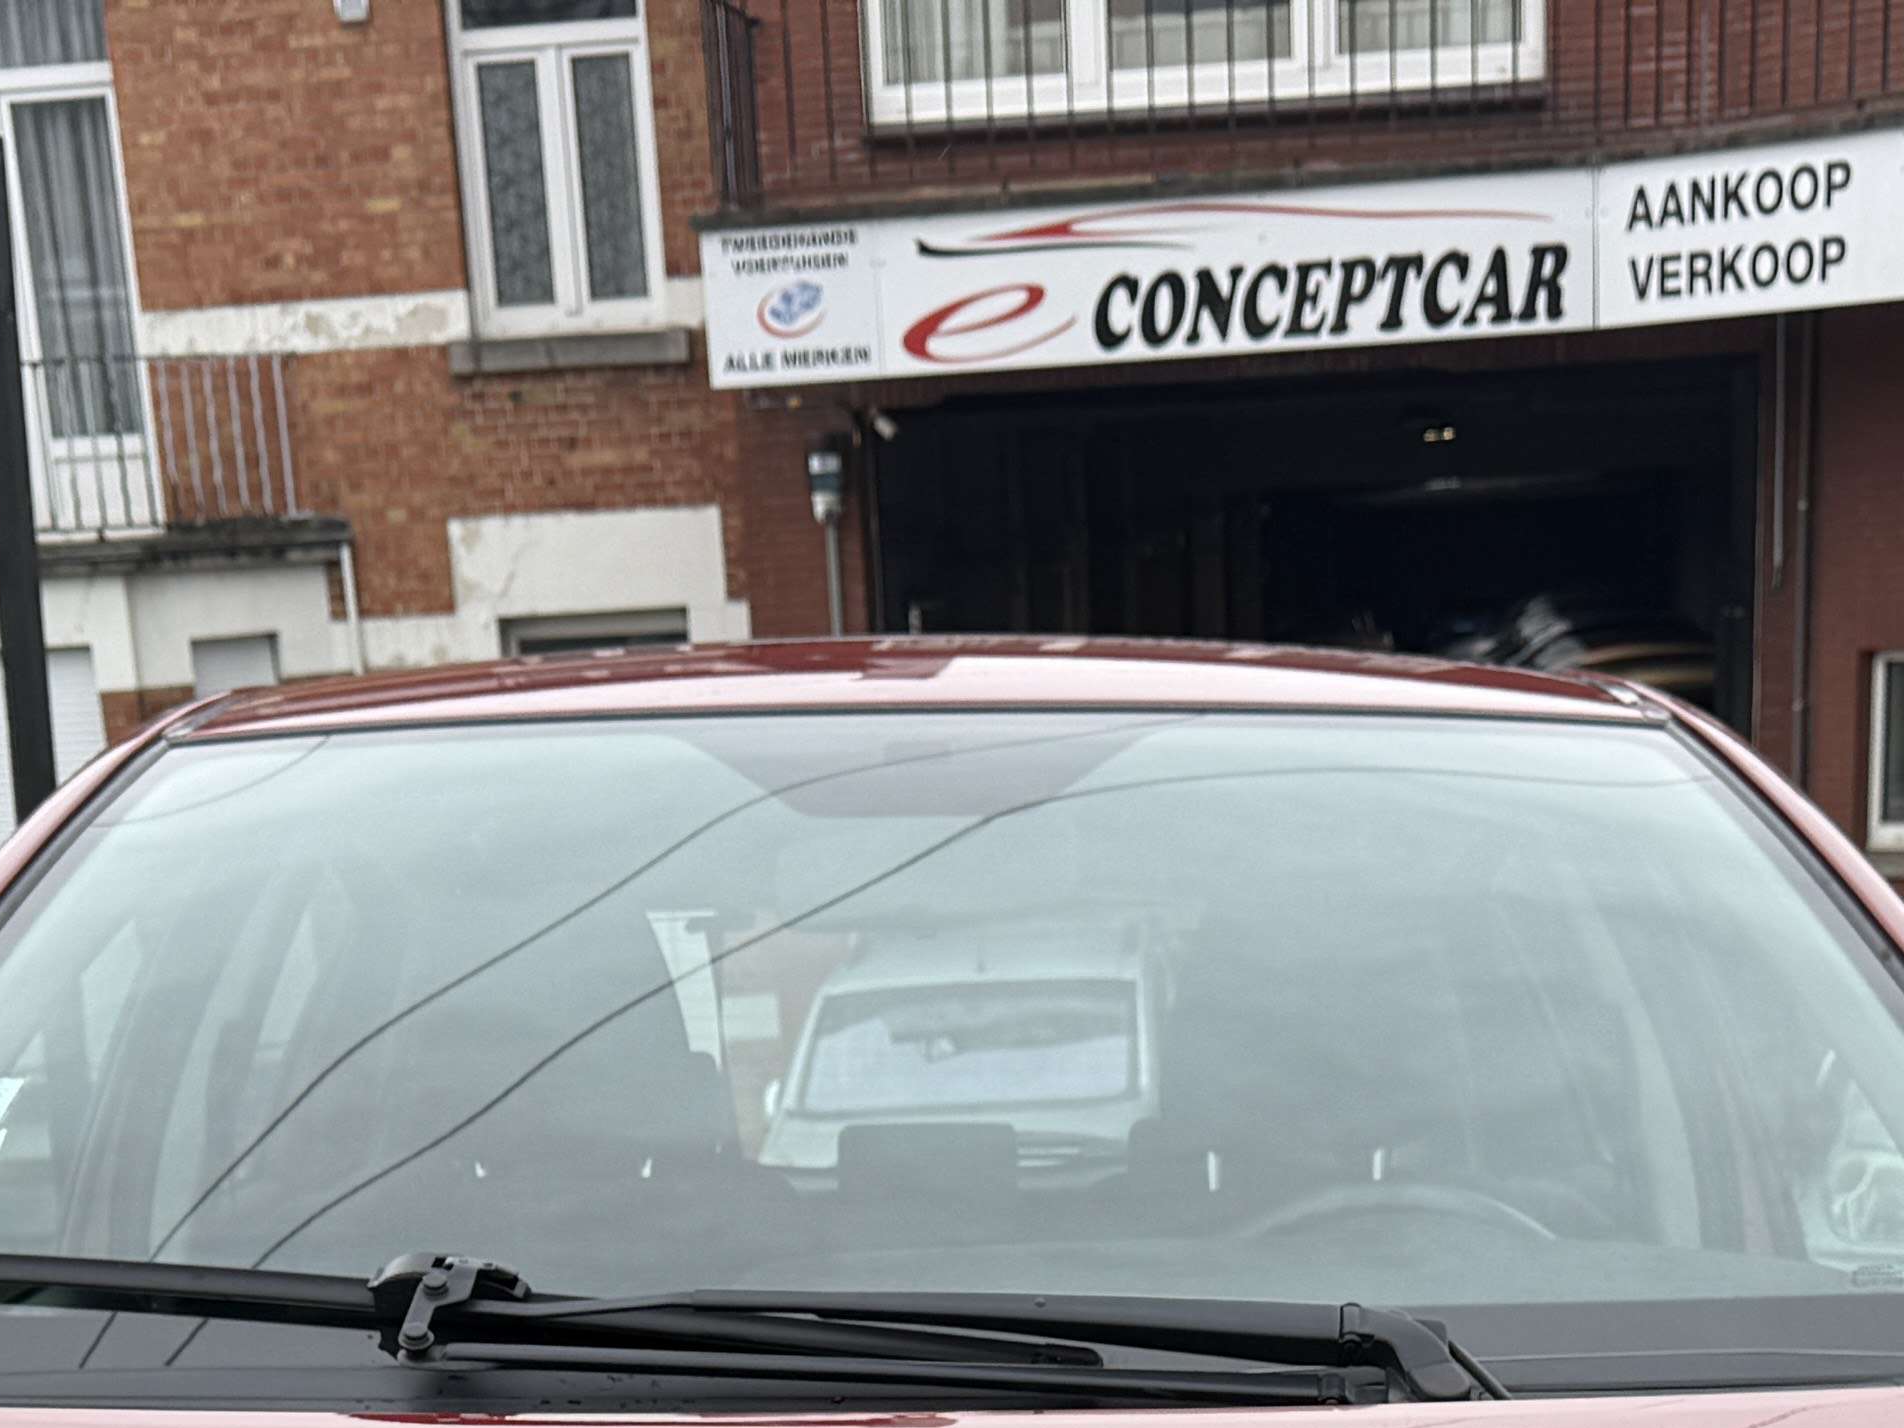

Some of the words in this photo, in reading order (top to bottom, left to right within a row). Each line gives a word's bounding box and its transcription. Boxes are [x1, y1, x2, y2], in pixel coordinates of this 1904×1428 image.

[1626, 160, 1852, 232] AANKOOP
[1094, 242, 1569, 352] CONCEPTCAR
[1628, 235, 1847, 300] VERKOOP
[723, 350, 774, 373] ALLE
[782, 346, 872, 369] MERKEN
